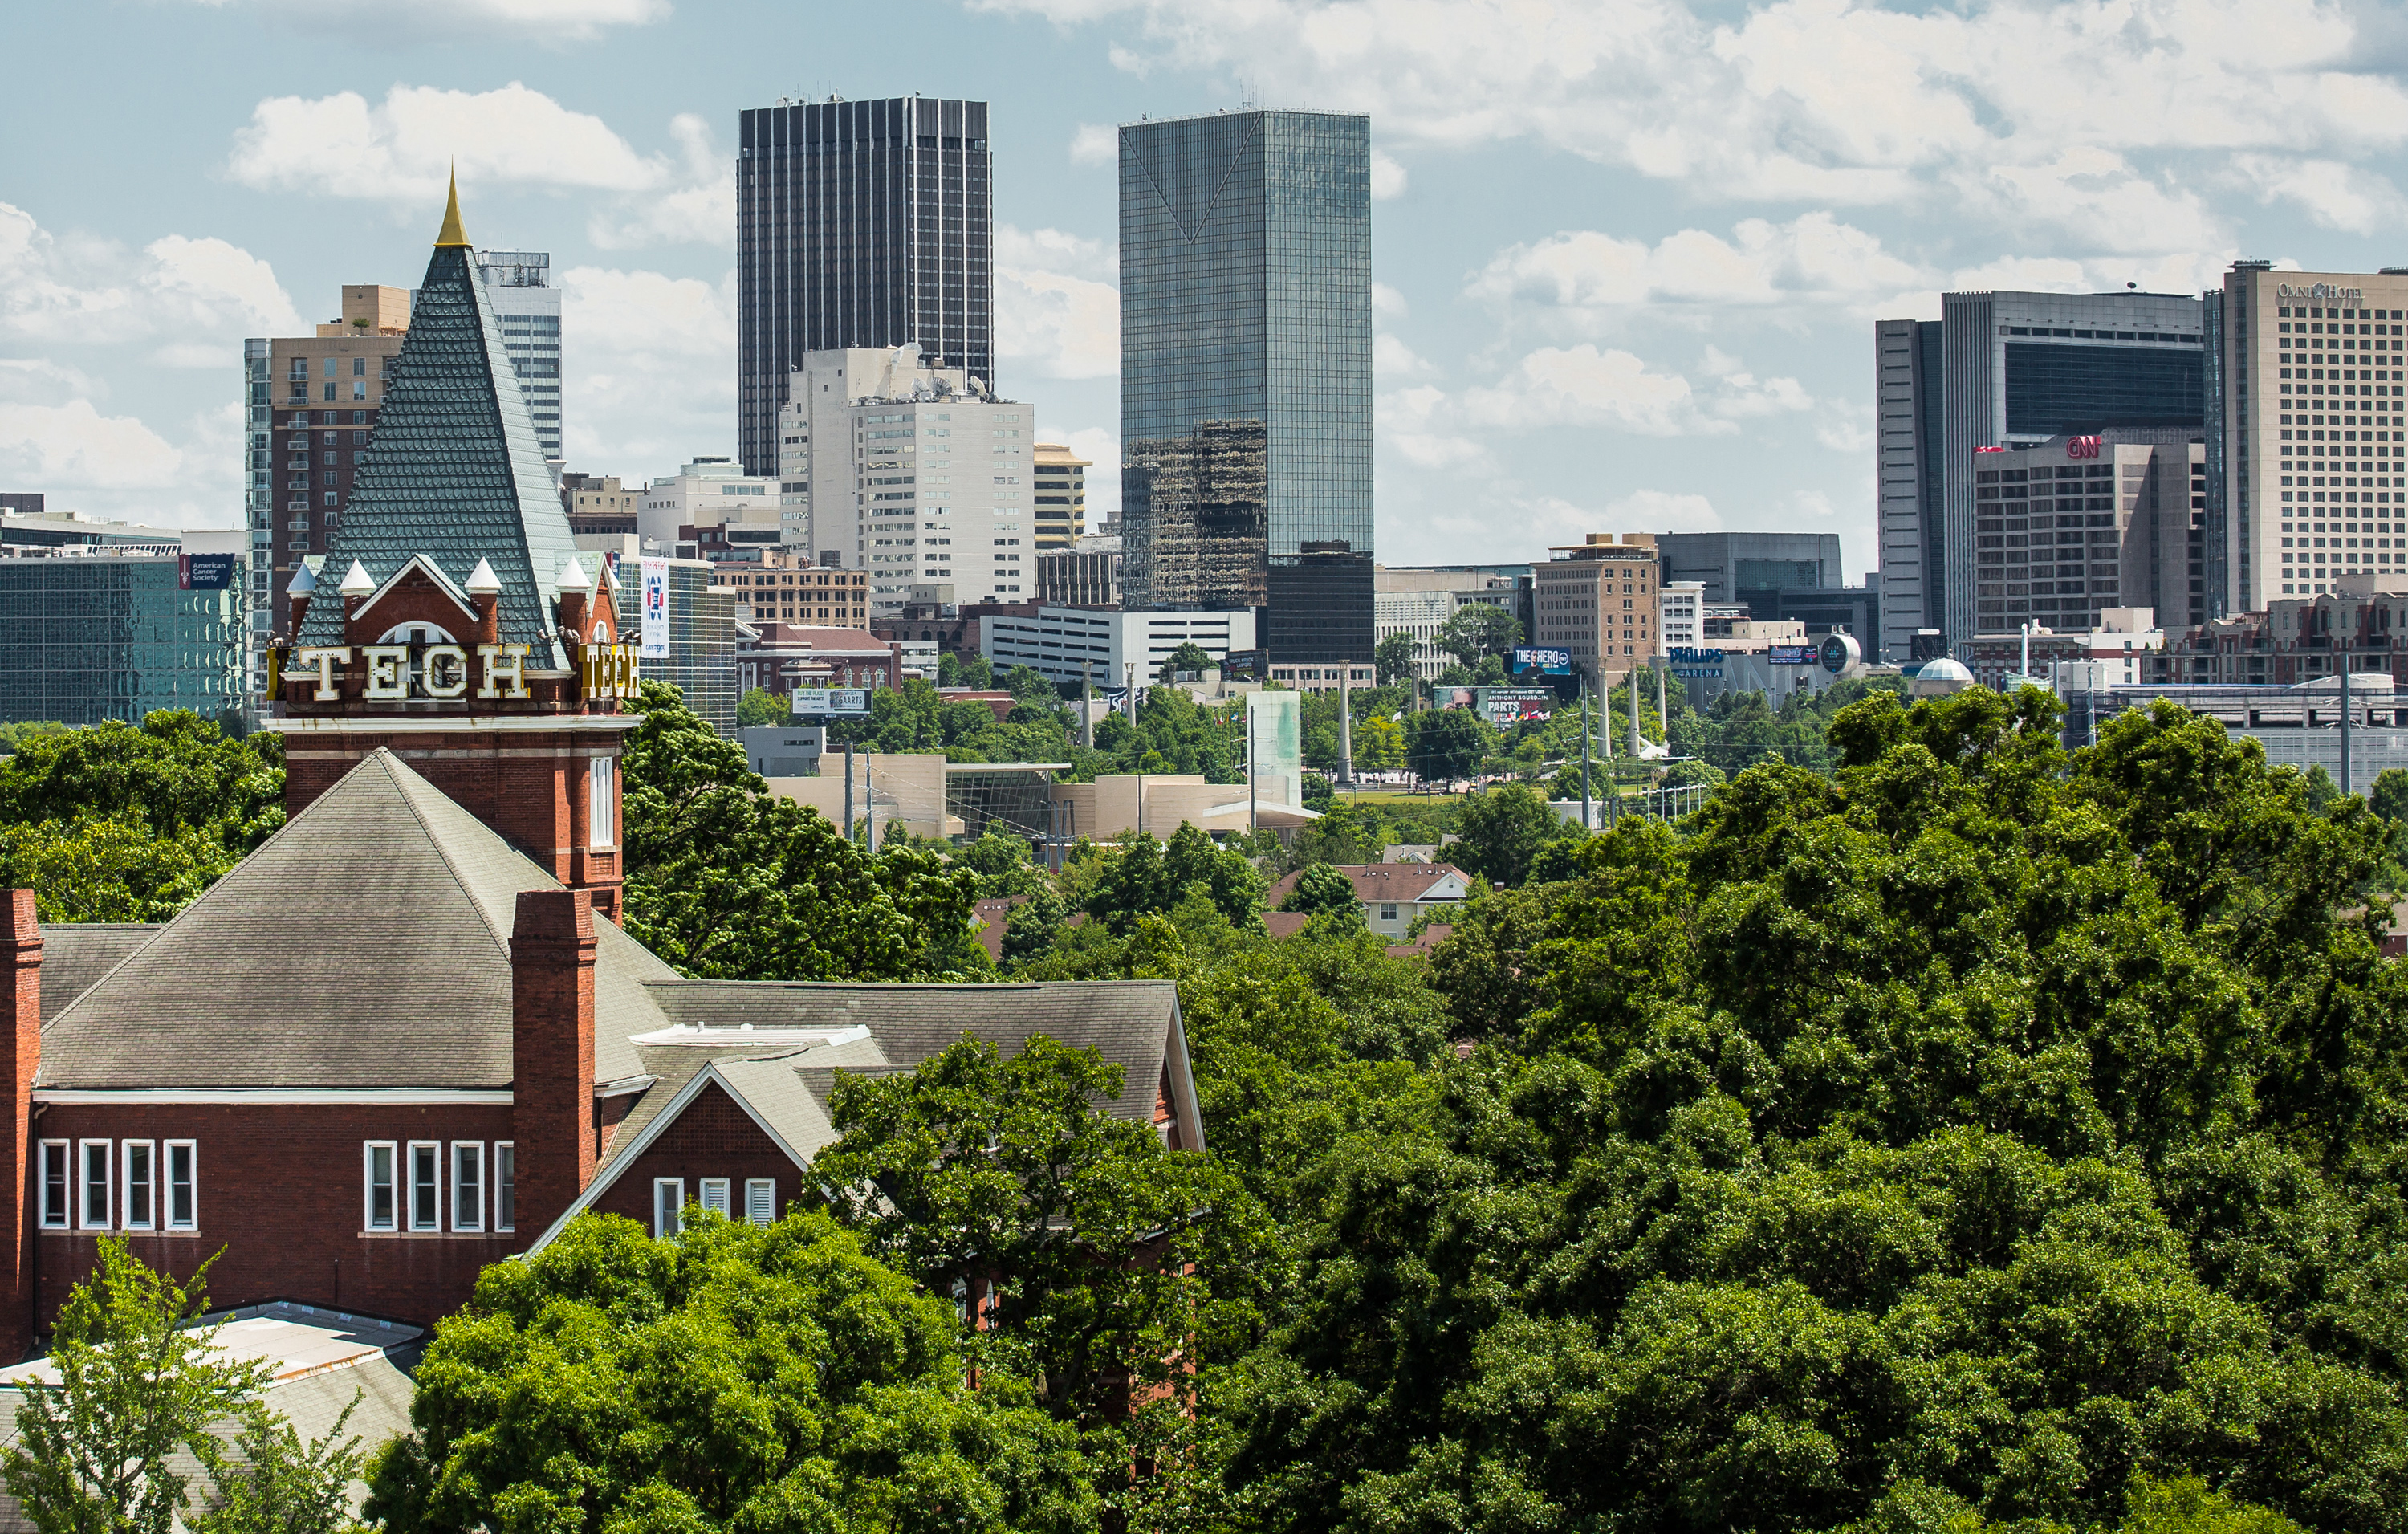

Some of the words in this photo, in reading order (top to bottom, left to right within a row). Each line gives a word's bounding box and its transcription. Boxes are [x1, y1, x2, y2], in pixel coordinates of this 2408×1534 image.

[2278, 282, 2312, 297] OMNI
[2327, 284, 2365, 299] HOTEL
[2067, 436, 2100, 459] CNN
[1516, 650, 1531, 662] THE
[1537, 650, 1558, 663] HERO
[1670, 648, 1723, 663] PHILIPS
[299, 646, 530, 701] TECH
[581, 644, 641, 698] TECH
[1488, 701, 1520, 712] PARTS
